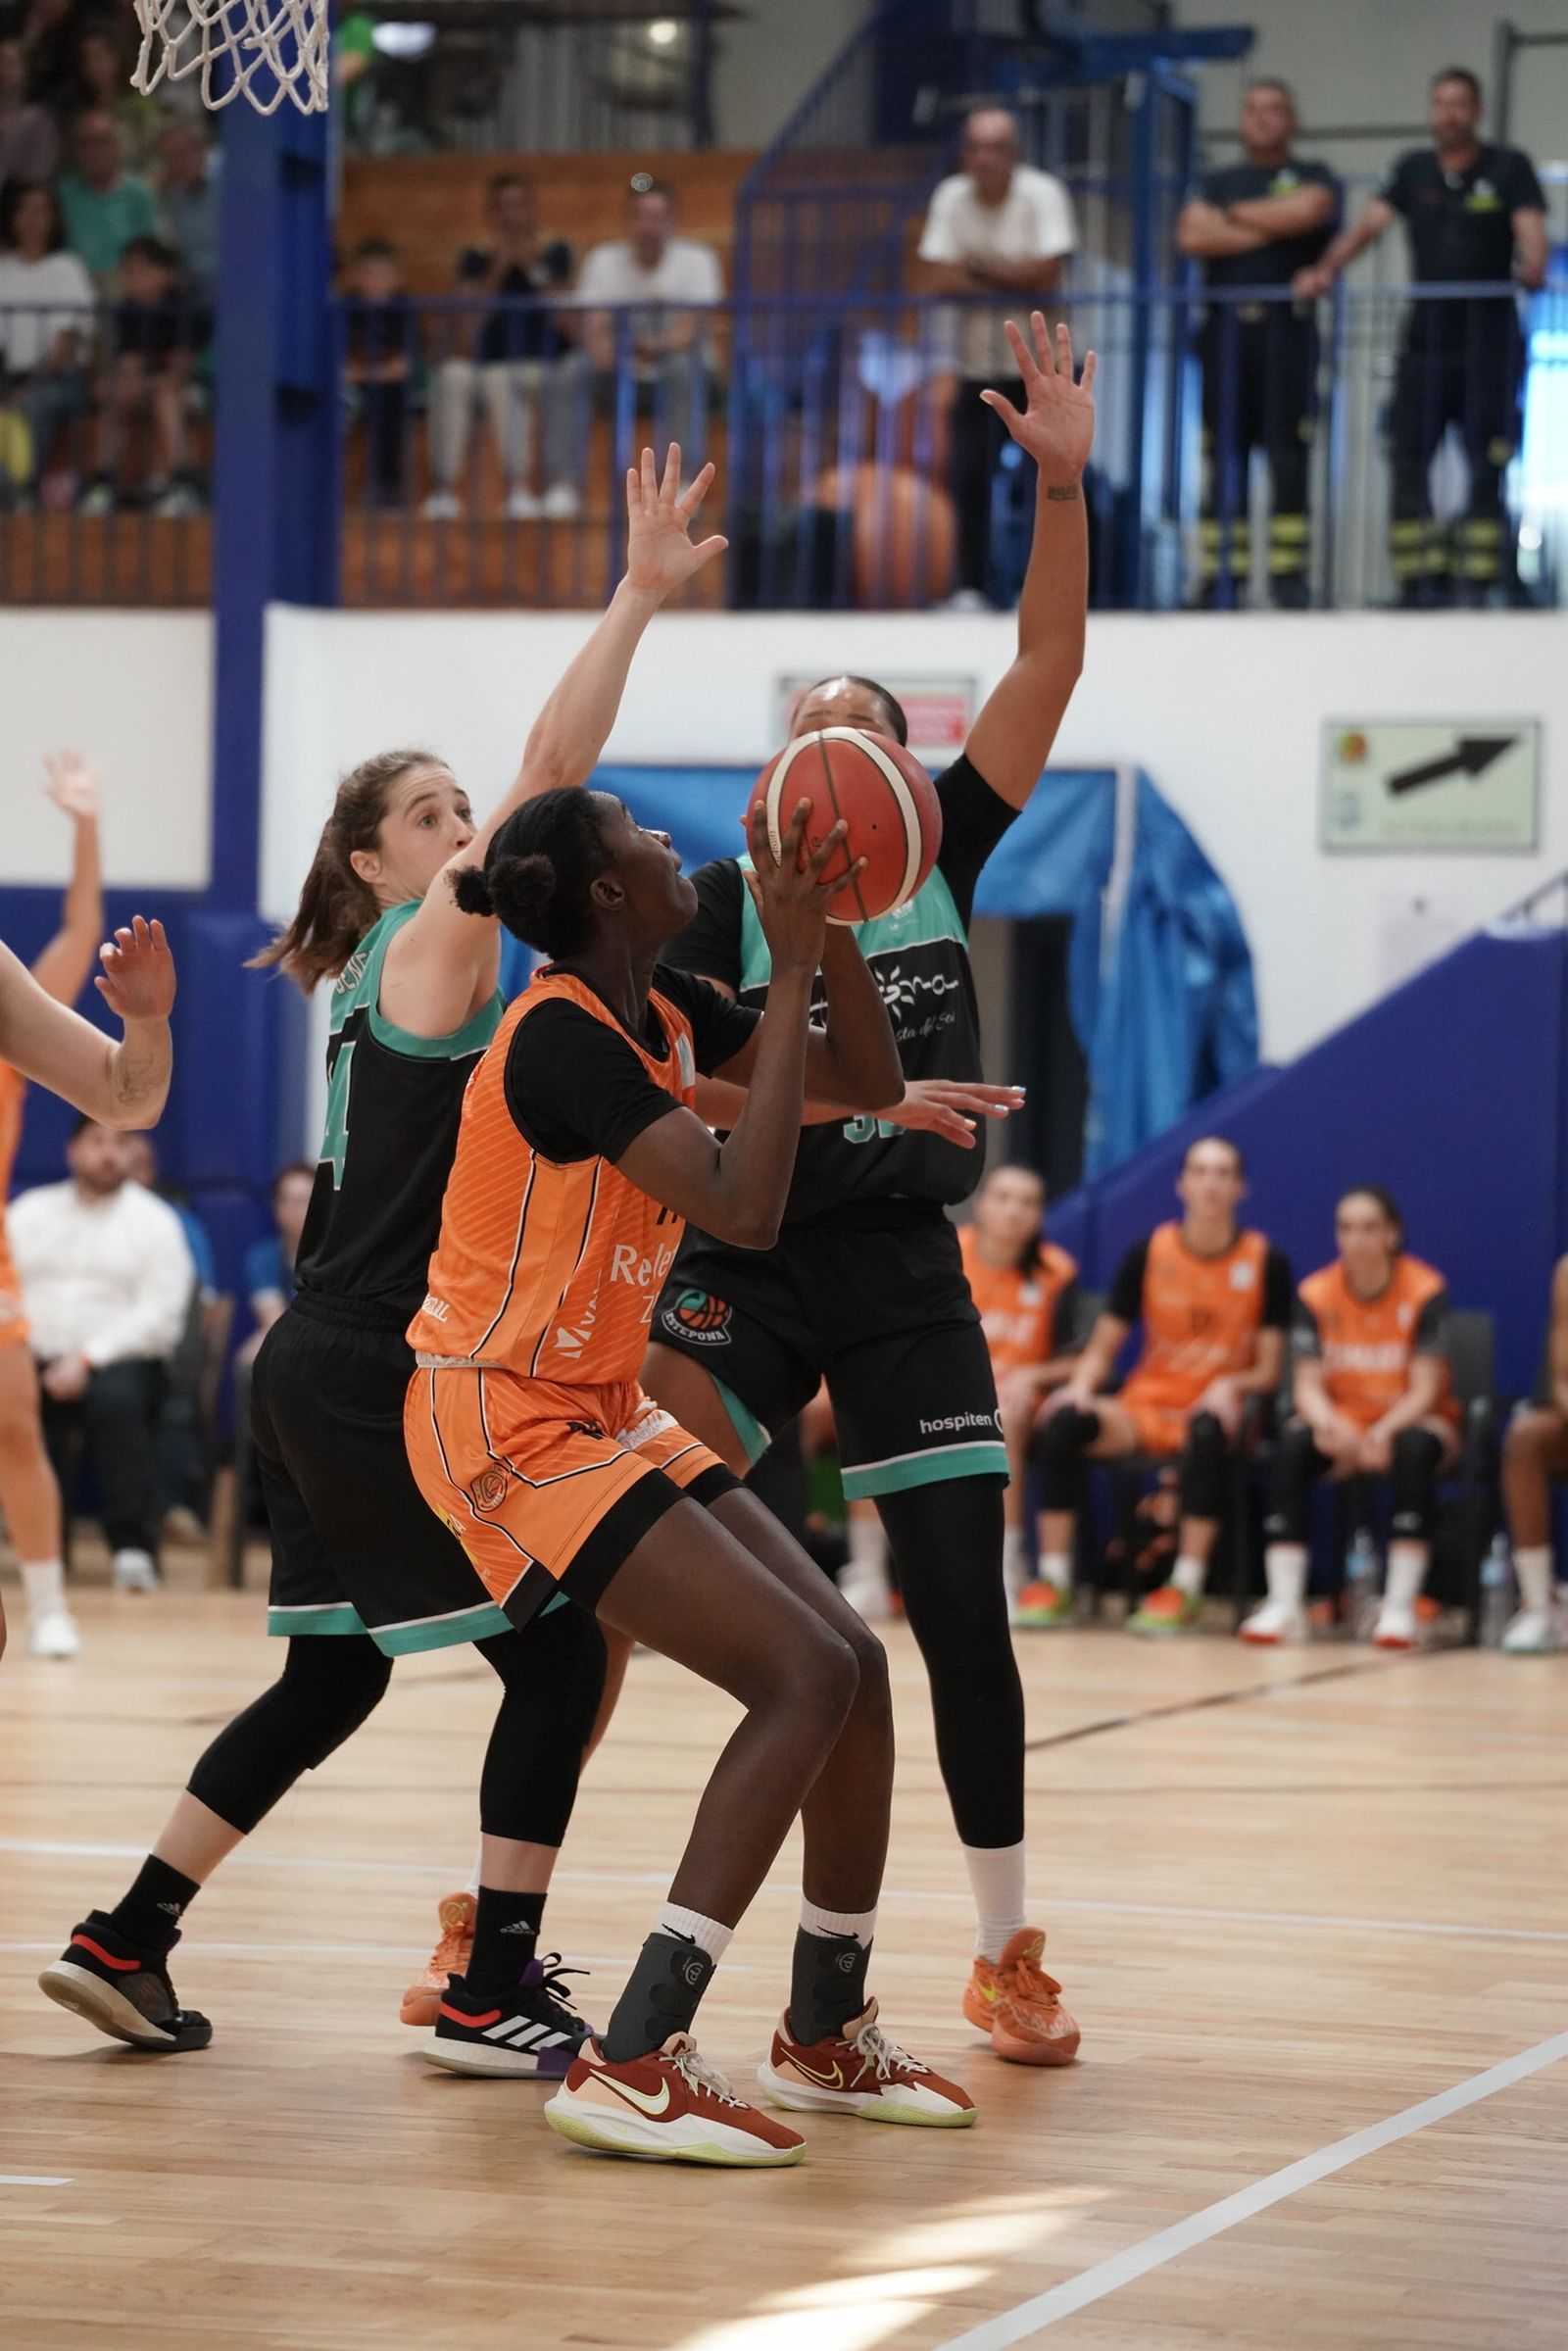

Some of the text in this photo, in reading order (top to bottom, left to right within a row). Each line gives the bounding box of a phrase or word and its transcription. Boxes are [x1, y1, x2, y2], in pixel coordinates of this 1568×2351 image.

[610, 1242, 679, 1286] Rele
[639, 1291, 660, 1324] Z
[665, 1312, 725, 1342] ESTEPONA
[919, 1411, 993, 1435] hospiten
